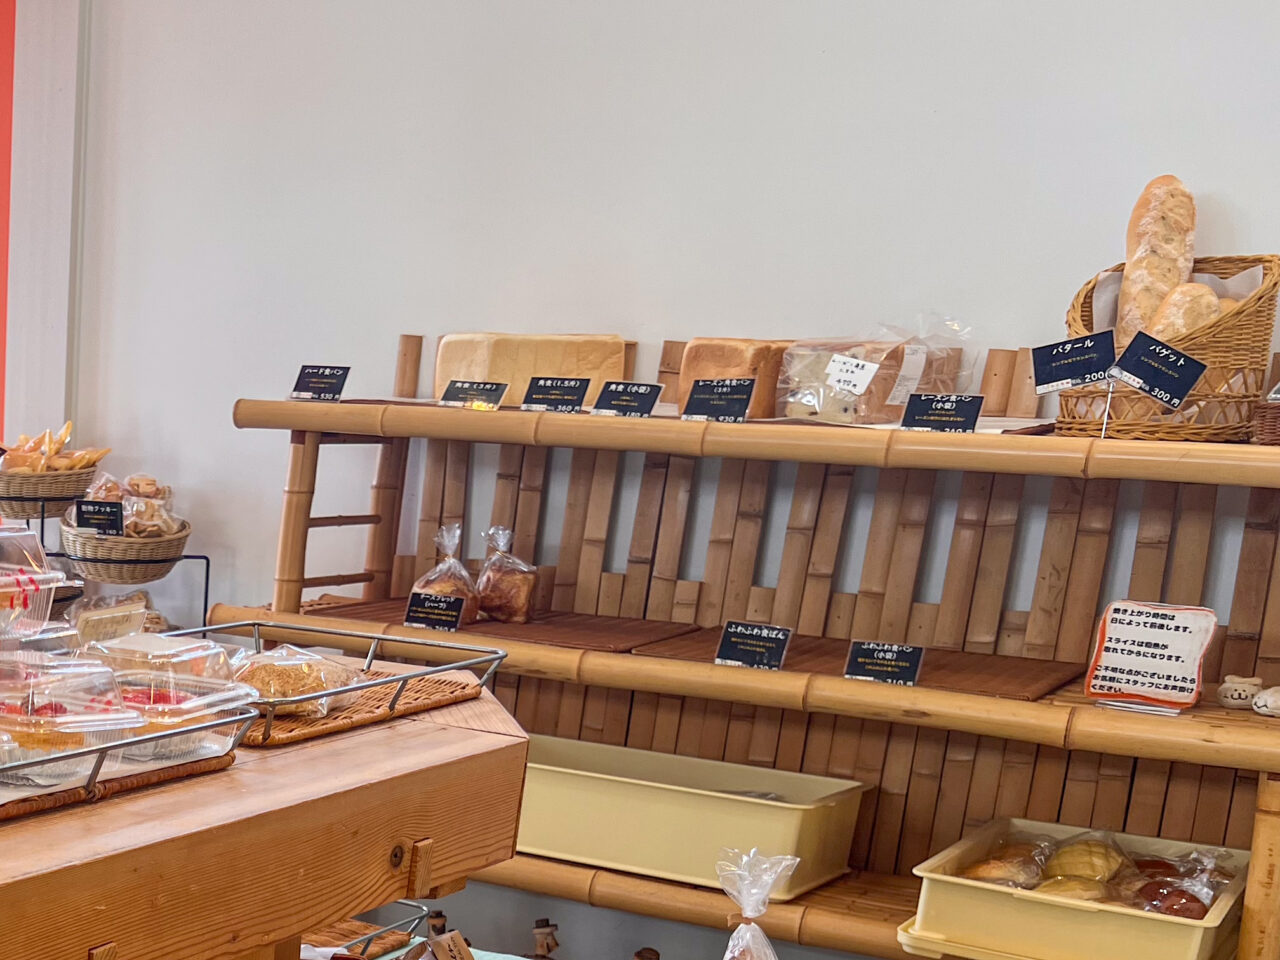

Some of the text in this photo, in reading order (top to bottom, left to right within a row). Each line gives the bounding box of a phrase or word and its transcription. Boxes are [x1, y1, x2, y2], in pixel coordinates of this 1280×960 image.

[1052, 339, 1094, 355] バタール
[1149, 345, 1185, 367] バゲット
[1085, 371, 1105, 382] 200
[1151, 388, 1171, 401] 300
[1171, 398, 1180, 407] 円
[1112, 607, 1176, 621] 焼き上がり時間は
[728, 625, 786, 640] ふわふわ食ぱん
[1110, 617, 1193, 634] 日によって前後します。
[1106, 636, 1169, 650] スライスは粗熱が
[1103, 646, 1185, 663] 取れてからになります。
[1095, 664, 1196, 685] ご不明な点がございましたら
[1091, 683, 1125, 694] ください。
